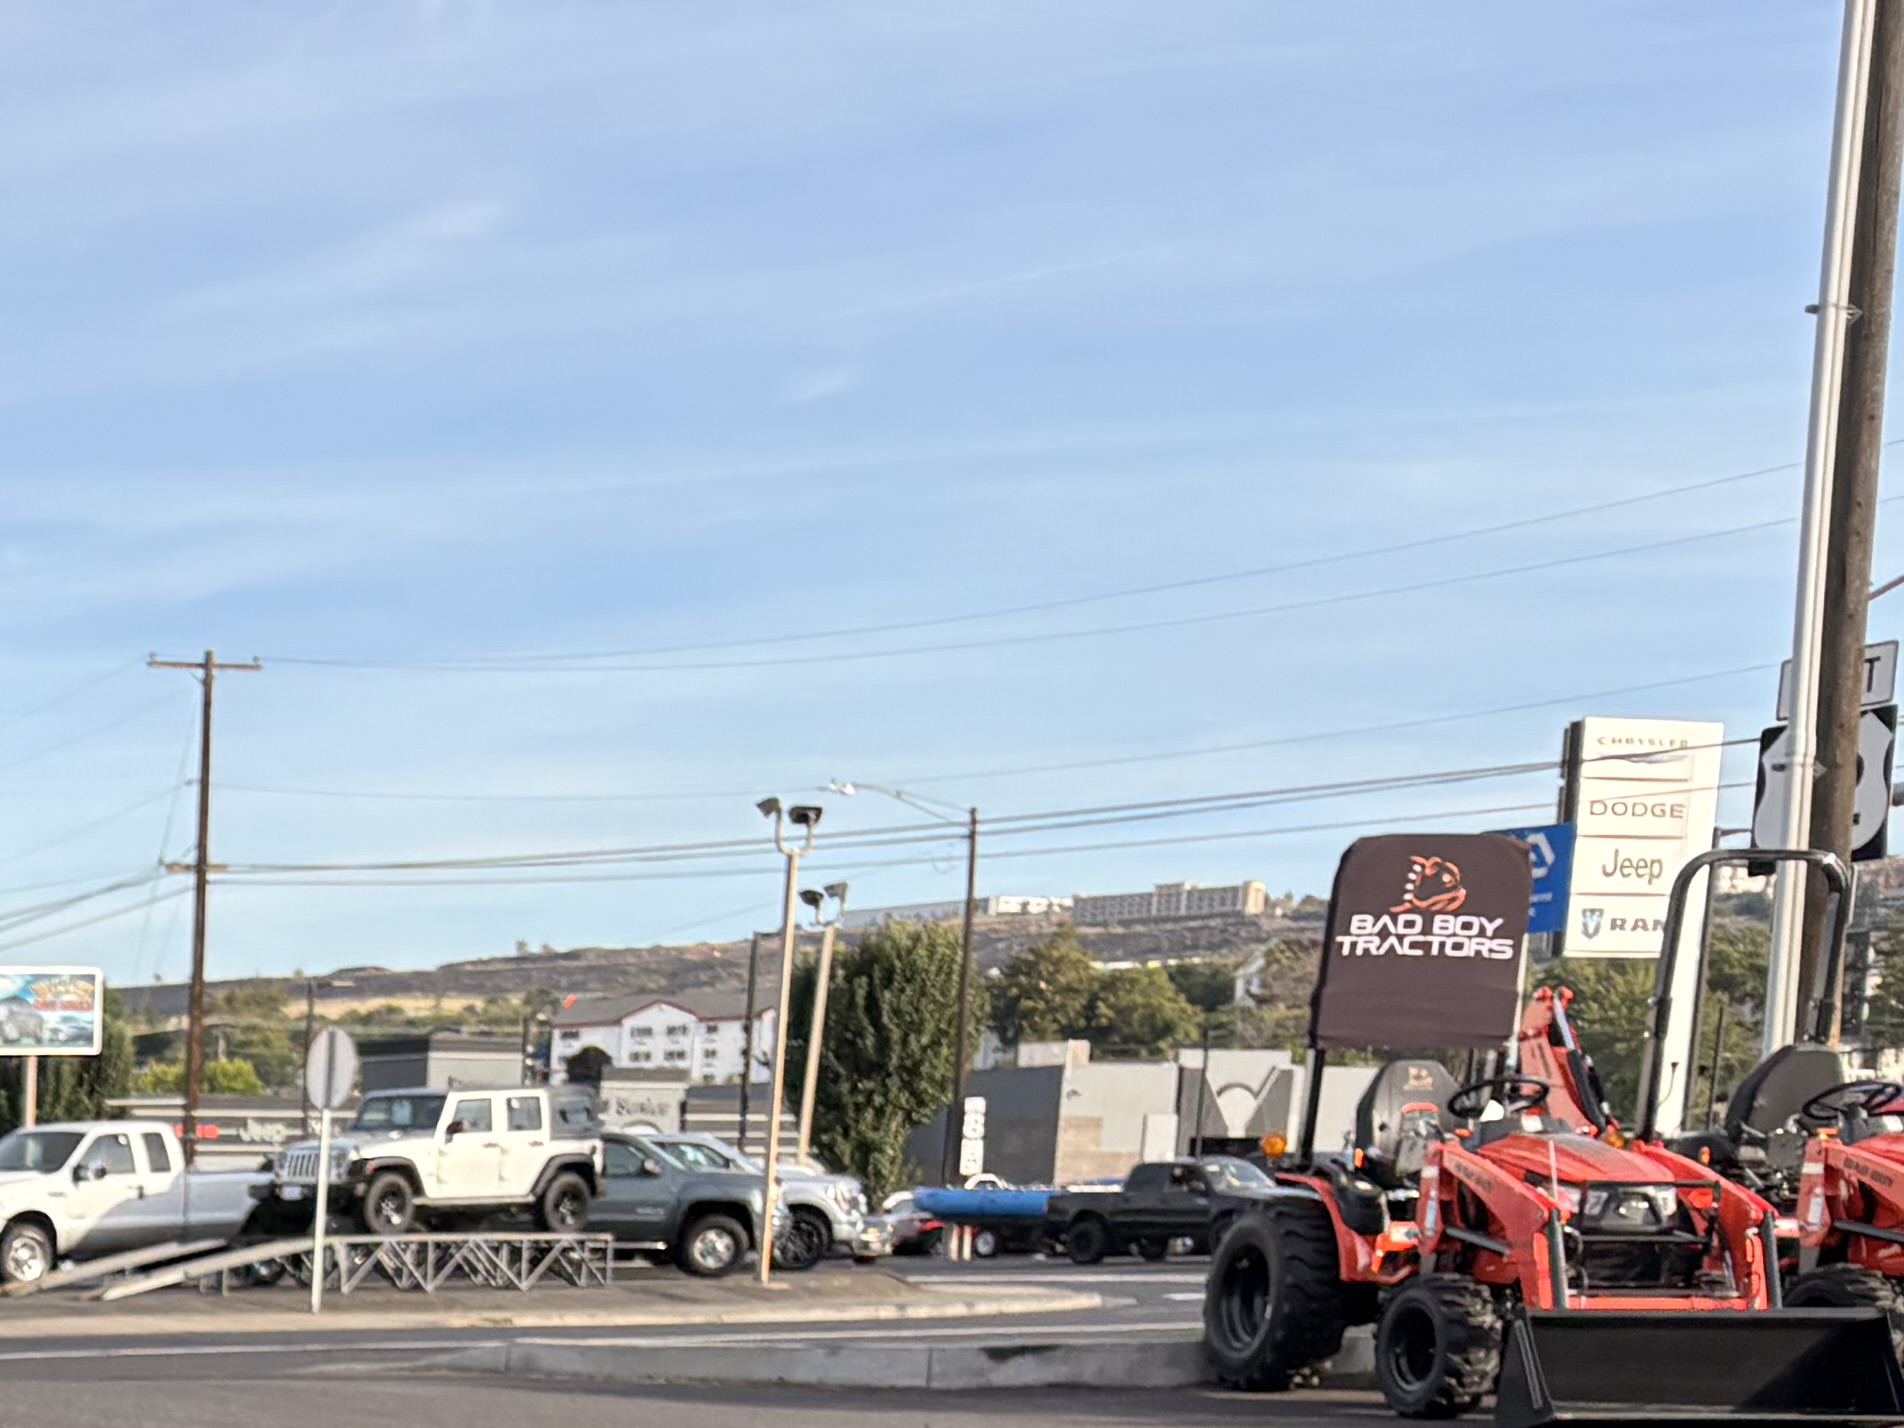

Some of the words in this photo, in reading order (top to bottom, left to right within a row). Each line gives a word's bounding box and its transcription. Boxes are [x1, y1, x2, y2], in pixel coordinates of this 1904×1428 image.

[1589, 800, 1687, 819] DODGE
[1601, 848, 1664, 885] Jeep
[1349, 913, 1423, 935] BAD
[1432, 914, 1504, 937] BOY
[1335, 935, 1515, 960] TRACTORS
